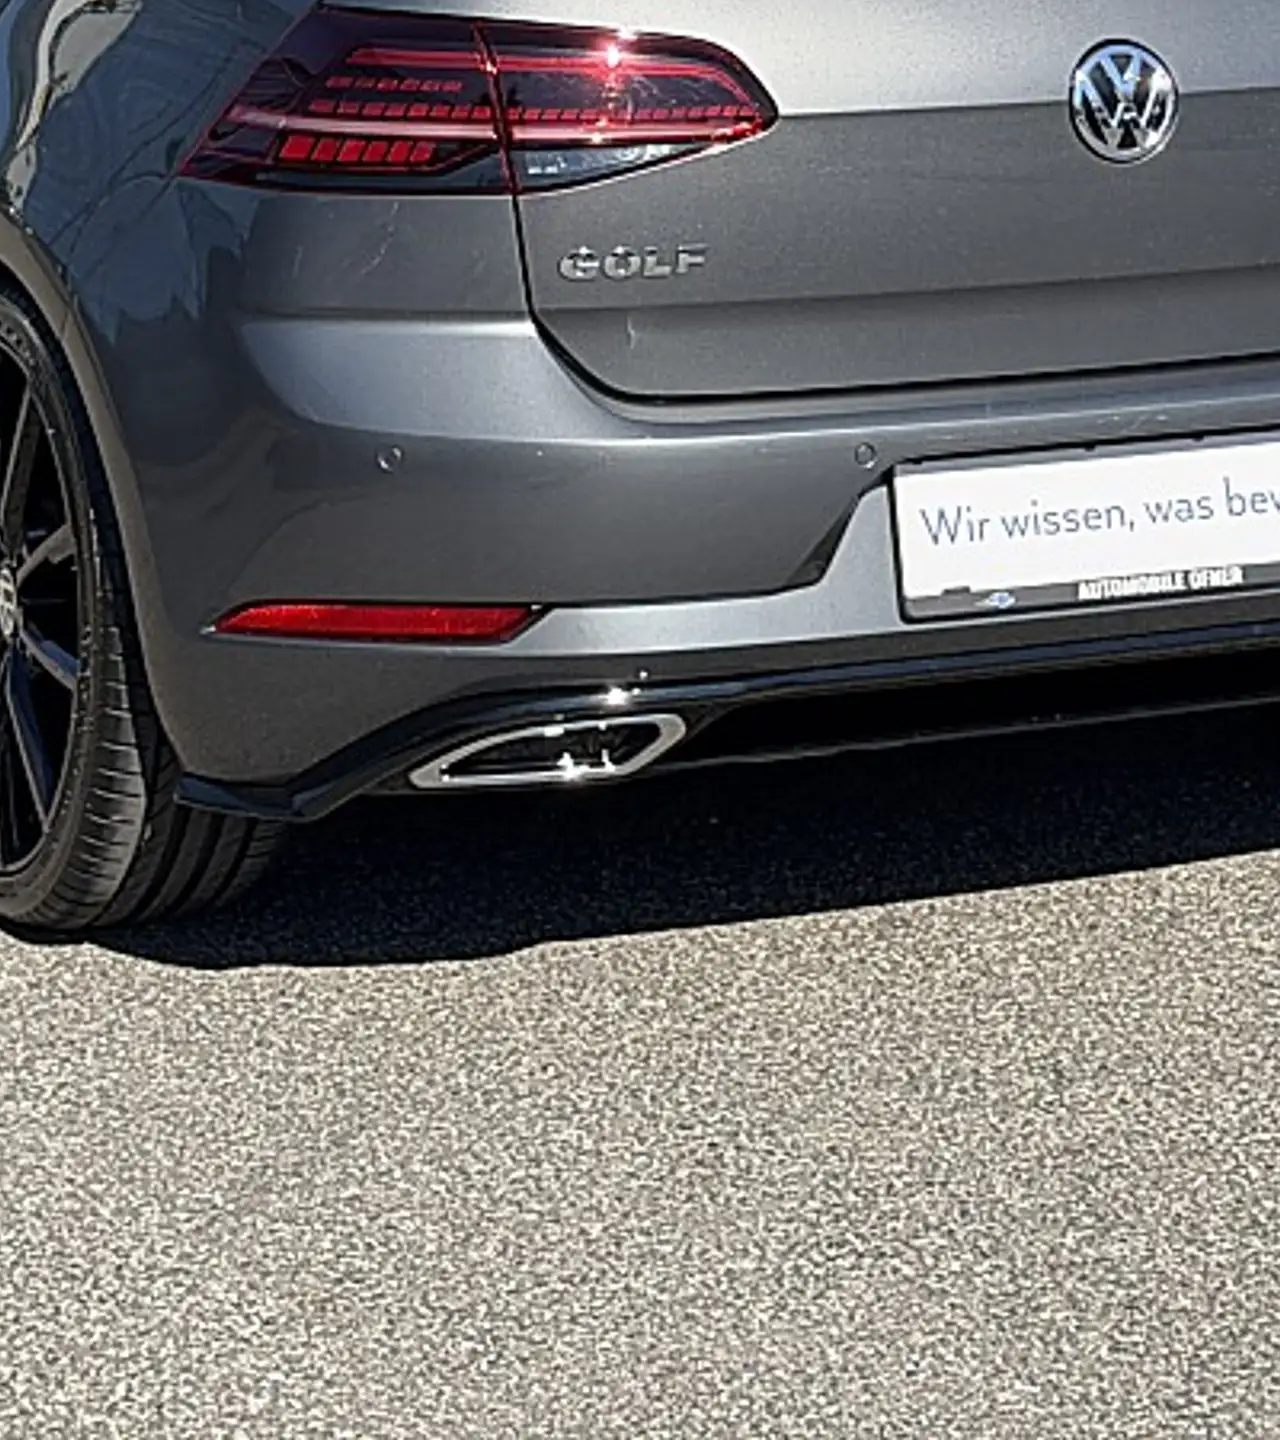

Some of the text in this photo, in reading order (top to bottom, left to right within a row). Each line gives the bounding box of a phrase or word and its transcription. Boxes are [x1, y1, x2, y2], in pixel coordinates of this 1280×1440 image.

[558, 243, 710, 281] GOLF
[919, 505, 990, 546] Wir
[1001, 498, 1135, 539] wissen,
[1143, 495, 1215, 523] was
